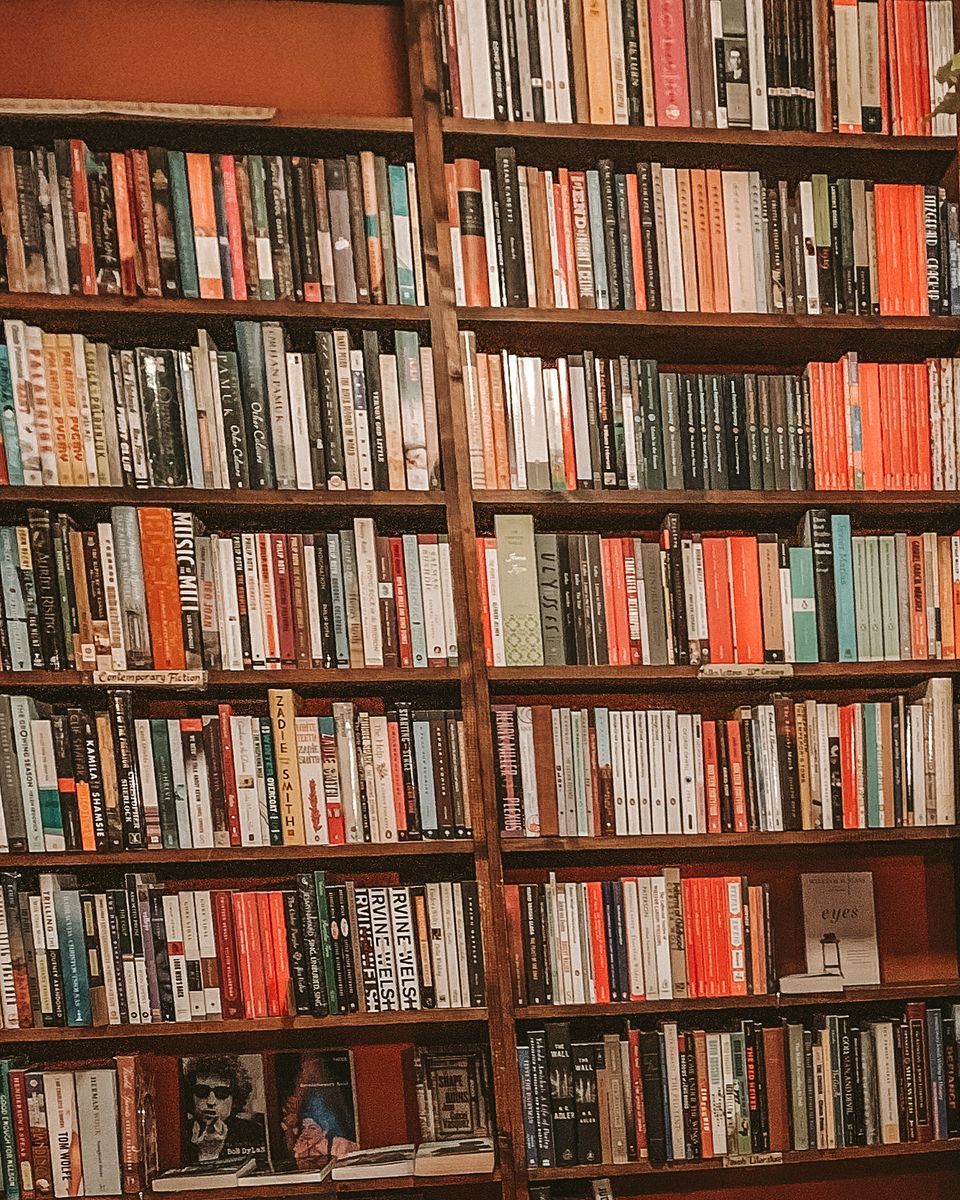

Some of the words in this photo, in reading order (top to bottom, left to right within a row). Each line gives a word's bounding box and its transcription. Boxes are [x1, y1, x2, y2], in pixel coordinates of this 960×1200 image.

[924, 195, 938, 246] FITZGERALD
[926, 257, 939, 300] CRACK-UP
[218, 355, 232, 417] PAMUK
[251, 402, 263, 429] Other
[230, 425, 241, 447] Other
[253, 430, 265, 464] Colours
[233, 448, 243, 476] Colours
[173, 512, 195, 565] MUSIC
[179, 575, 199, 611] MILL
[203, 581, 212, 600] RED
[540, 553, 559, 632] ULYSSES
[41, 596, 56, 634] RISING
[203, 603, 213, 628] JOAN
[99, 672, 166, 683] Contemporary
[168, 672, 201, 683] Fiction
[19, 719, 32, 758] GROWING
[495, 709, 515, 740] HENRY
[276, 696, 288, 753] ZADIE
[282, 769, 295, 826] SMITH
[321, 733, 336, 764] ZADIE
[498, 742, 518, 776] MILLER
[24, 759, 33, 788] SEASON
[86, 740, 97, 780] KAMILA
[92, 792, 104, 837] SHAMSIE
[325, 768, 339, 798] SMITH
[267, 777, 278, 812] OVERCOAT
[502, 797, 522, 831] PLEXUS
[43, 890, 53, 933] TRILLING
[371, 888, 390, 947] IRVINE
[392, 887, 411, 946] IRVINE
[821, 907, 859, 923] eyes
[676, 918, 684, 951] Childhood
[377, 952, 395, 1011] WELSH
[399, 951, 417, 1010] WELSH
[551, 1050, 570, 1058] WALL
[90, 1077, 99, 1111] HERMAN
[2, 1117, 12, 1144] ENOUGH
[14, 1077, 24, 1132] HENDERSON'S
[19, 1133, 27, 1157] SPEAR
[554, 1111, 575, 1120] ADLER
[5, 1145, 13, 1158] FOR
[58, 1132, 69, 1150] TOM
[60, 1152, 72, 1181] WOLFE
